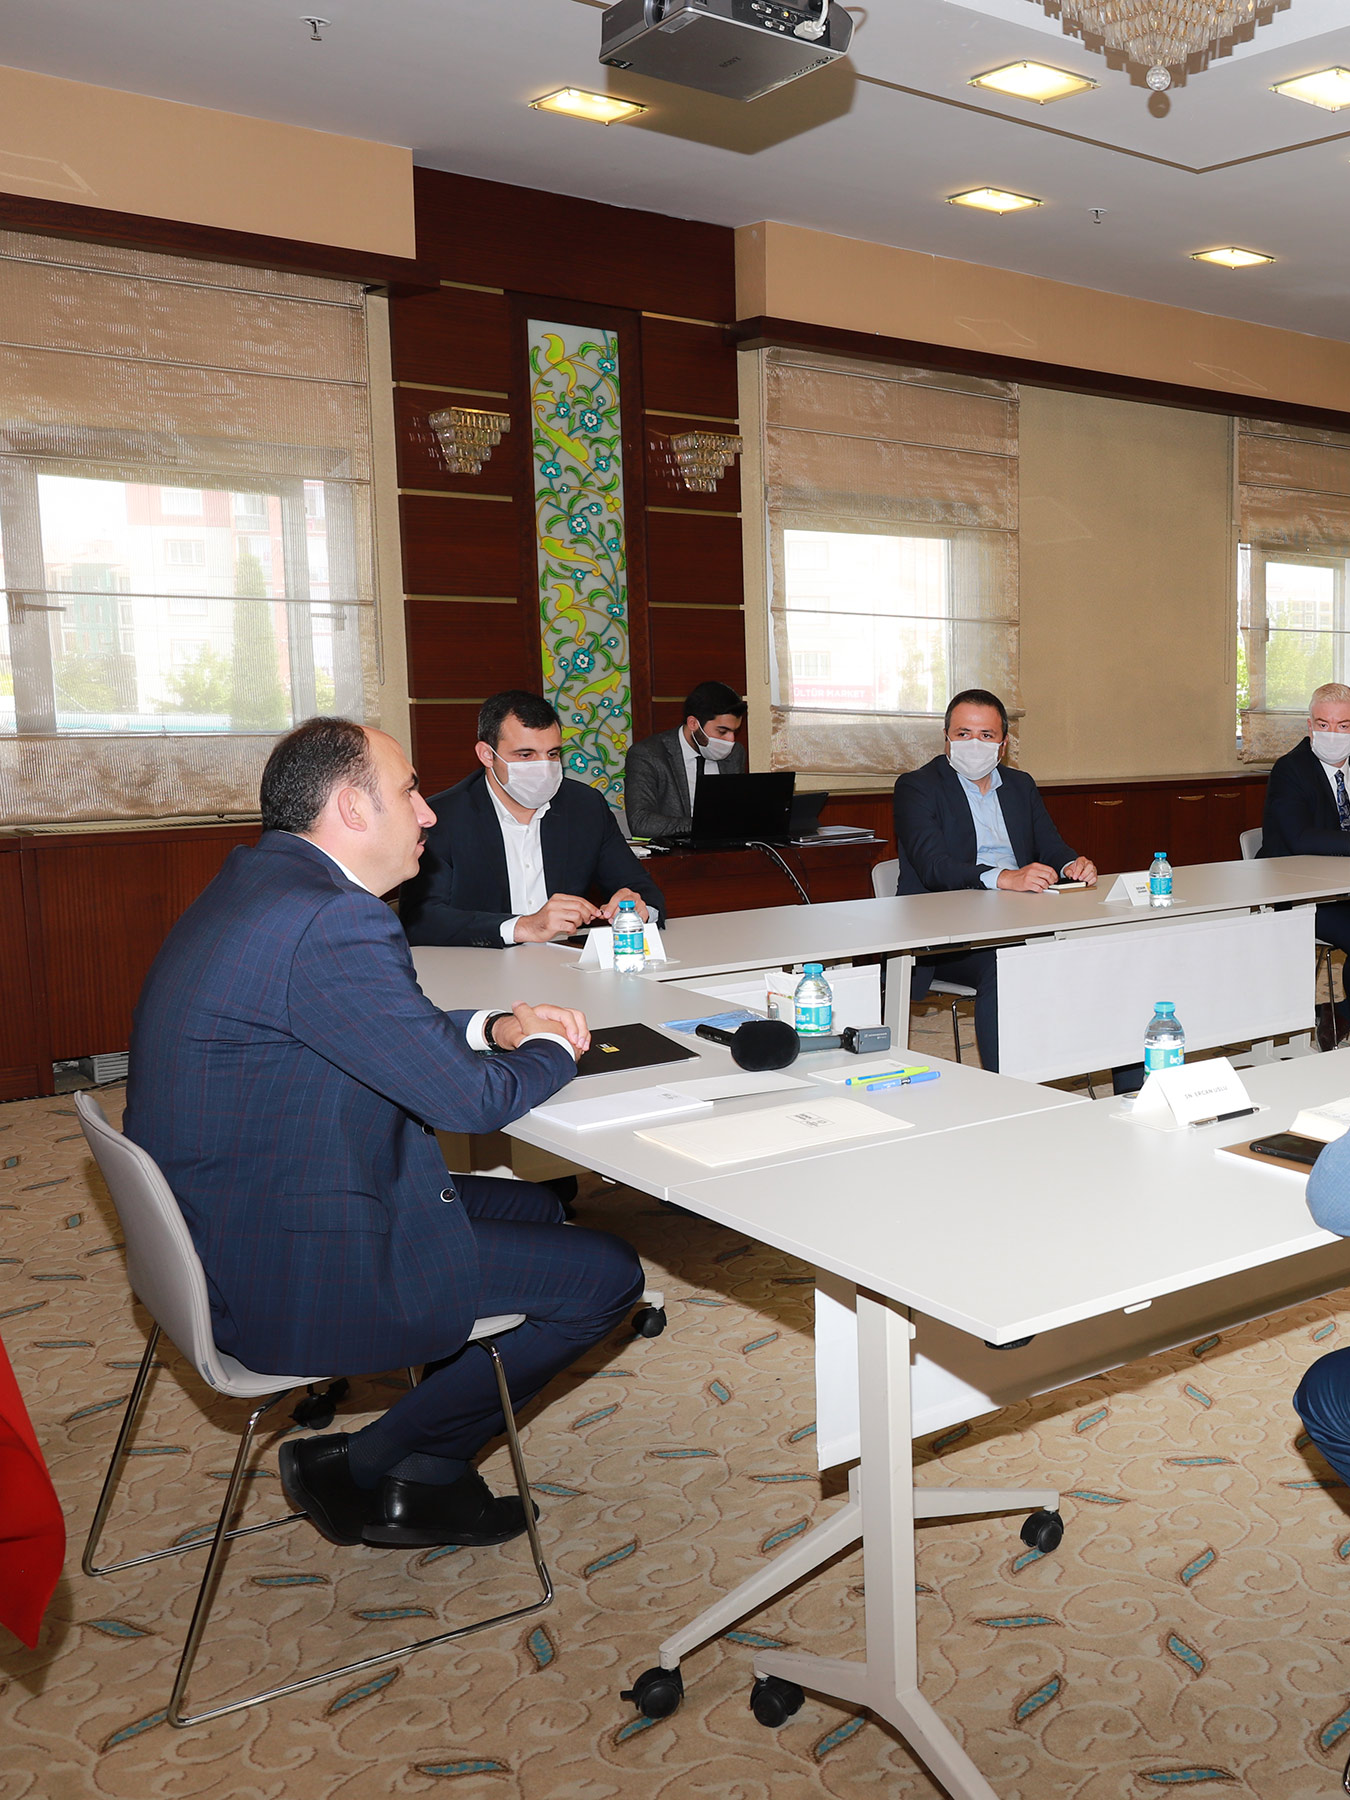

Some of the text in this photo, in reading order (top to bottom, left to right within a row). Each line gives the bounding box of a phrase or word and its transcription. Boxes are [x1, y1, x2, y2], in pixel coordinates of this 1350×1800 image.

[793, 687, 865, 698] ÜLTÜR MARKET
[1193, 1089, 1213, 1097] ERCAN
